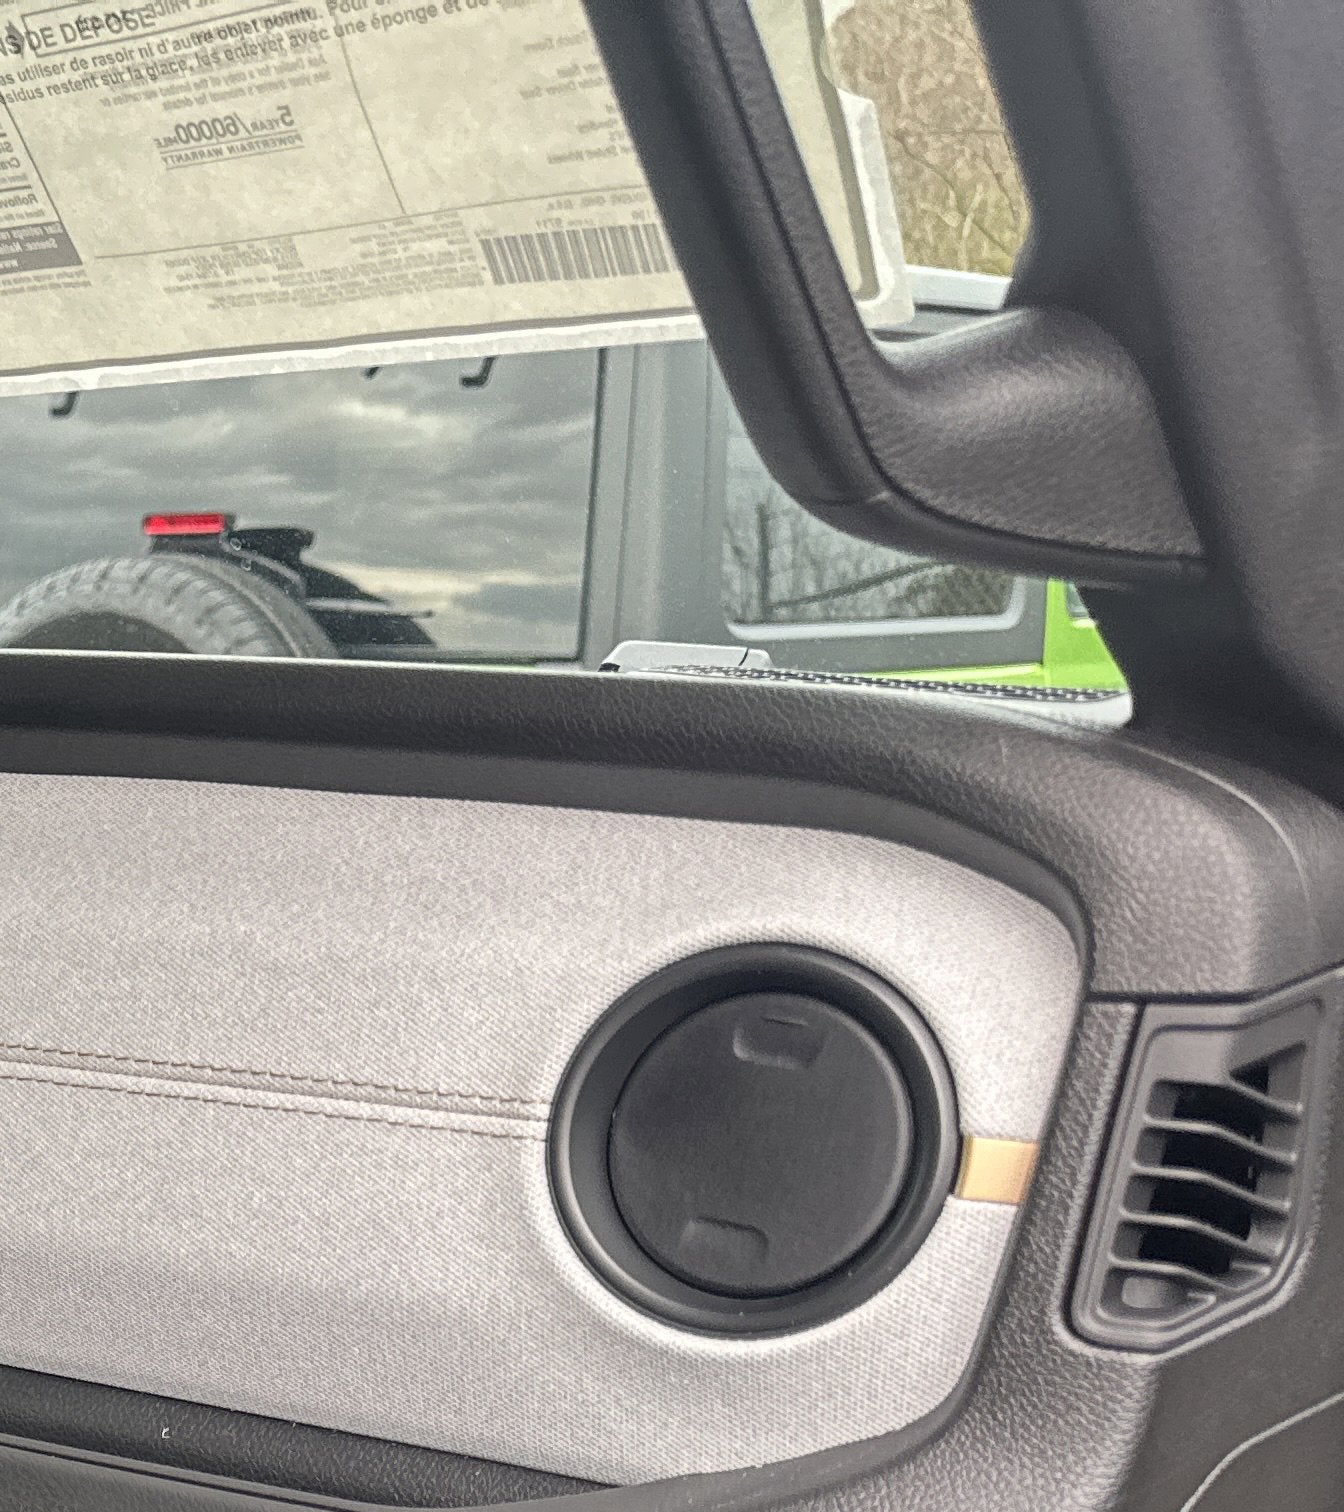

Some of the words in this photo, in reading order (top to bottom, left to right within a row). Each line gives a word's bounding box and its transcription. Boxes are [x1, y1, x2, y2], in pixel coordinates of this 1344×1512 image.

[27, 25, 54, 51] DE
[47, 74, 98, 97] restent
[100, 70, 126, 87] sur
[127, 63, 144, 81] la
[289, 28, 330, 52] avec
[333, 21, 366, 40] une
[369, 4, 439, 34] éponge
[442, 0, 462, 17] et
[17, 62, 67, 82] utiliser
[70, 56, 89, 74] de
[92, 46, 136, 70] rasoir
[139, 45, 153, 61] ni
